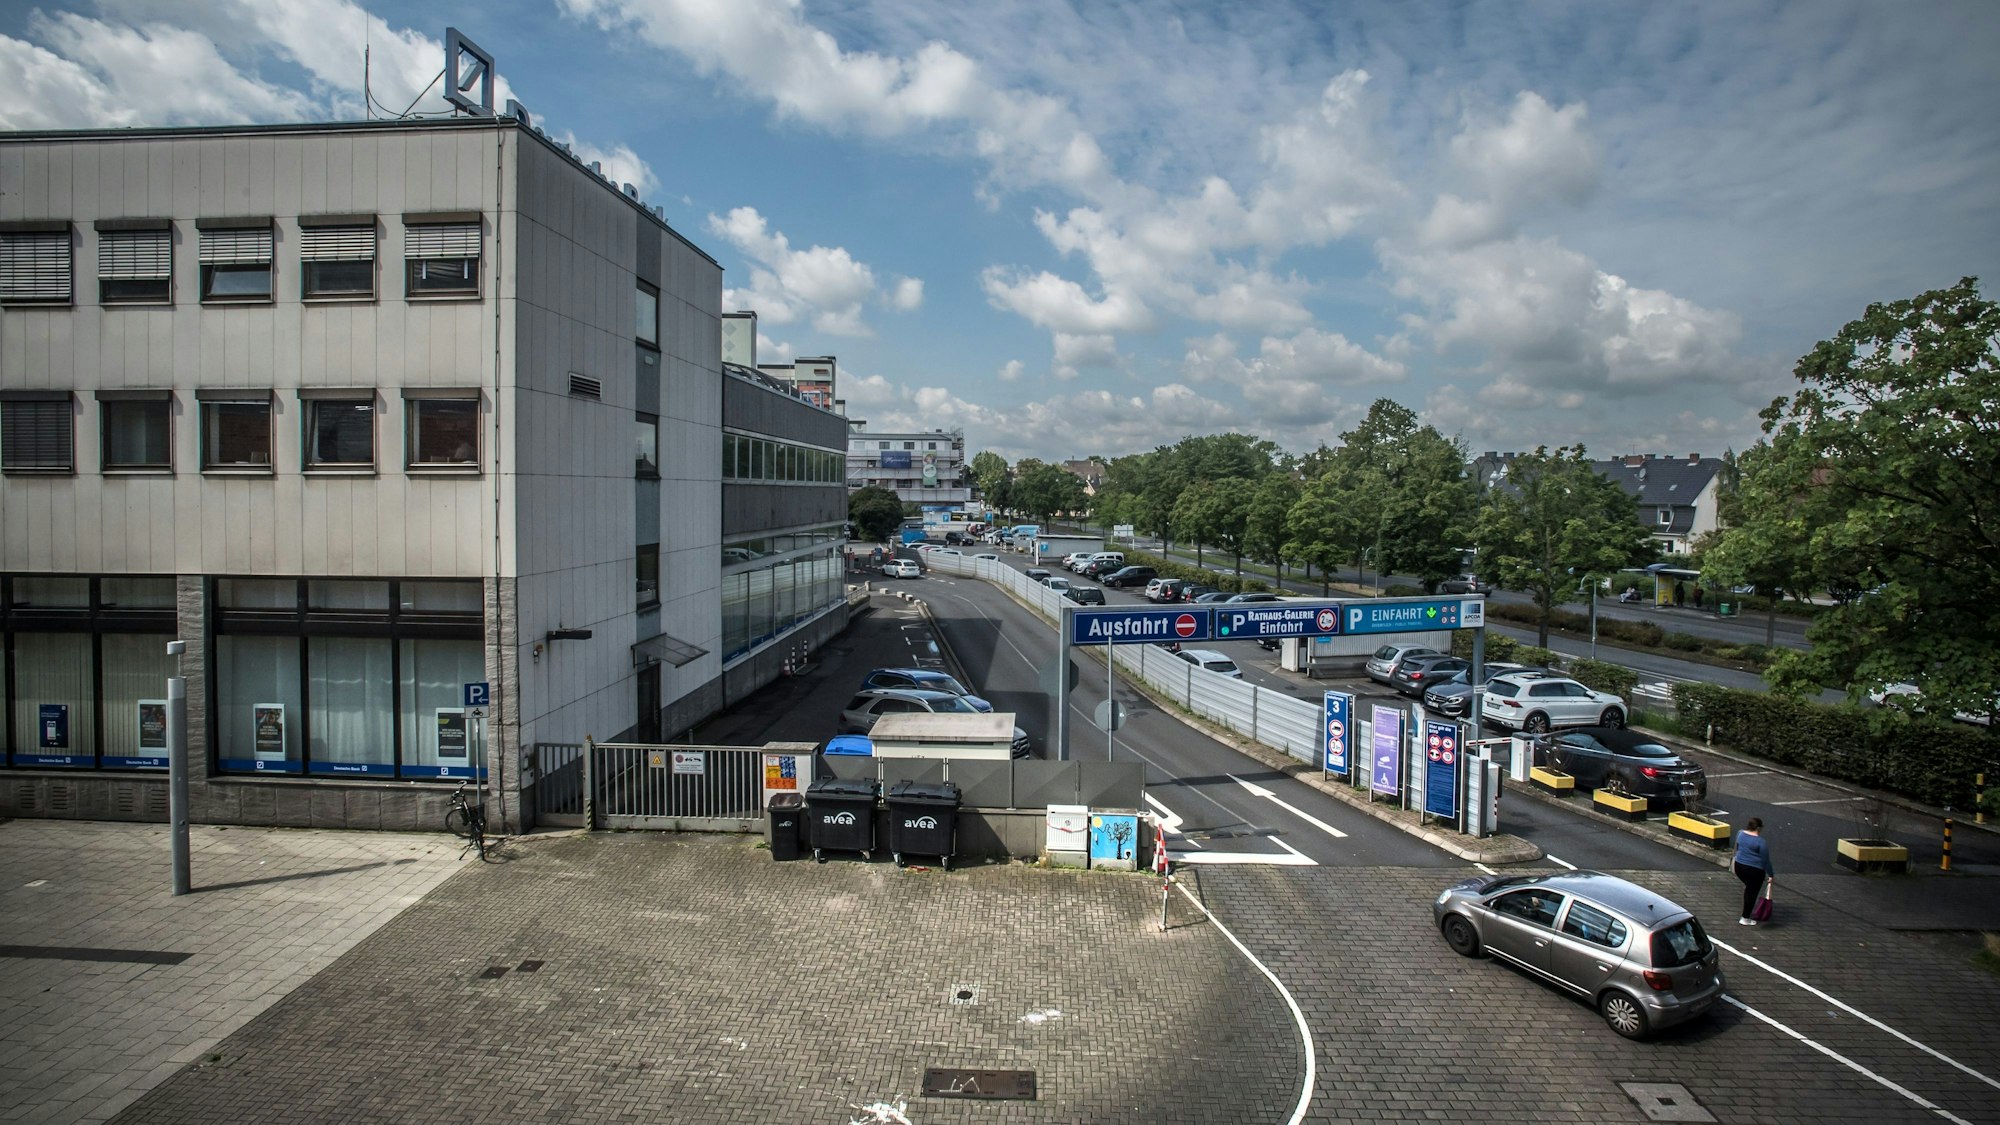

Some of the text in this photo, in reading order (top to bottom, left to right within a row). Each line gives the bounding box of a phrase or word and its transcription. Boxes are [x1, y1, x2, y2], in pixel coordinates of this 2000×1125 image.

[1248, 610, 1314, 621] RATHAUS-GALERIE
[1350, 609, 1363, 630] P
[1372, 608, 1423, 621] EINFAHRT
[1088, 617, 1168, 637] Ausfahrt
[1232, 614, 1245, 632] P
[1260, 621, 1303, 634] Einfahrt
[470, 685, 483, 704] P
[1333, 701, 1340, 713] 3
[824, 813, 854, 825] avea
[904, 817, 935, 829] avea
